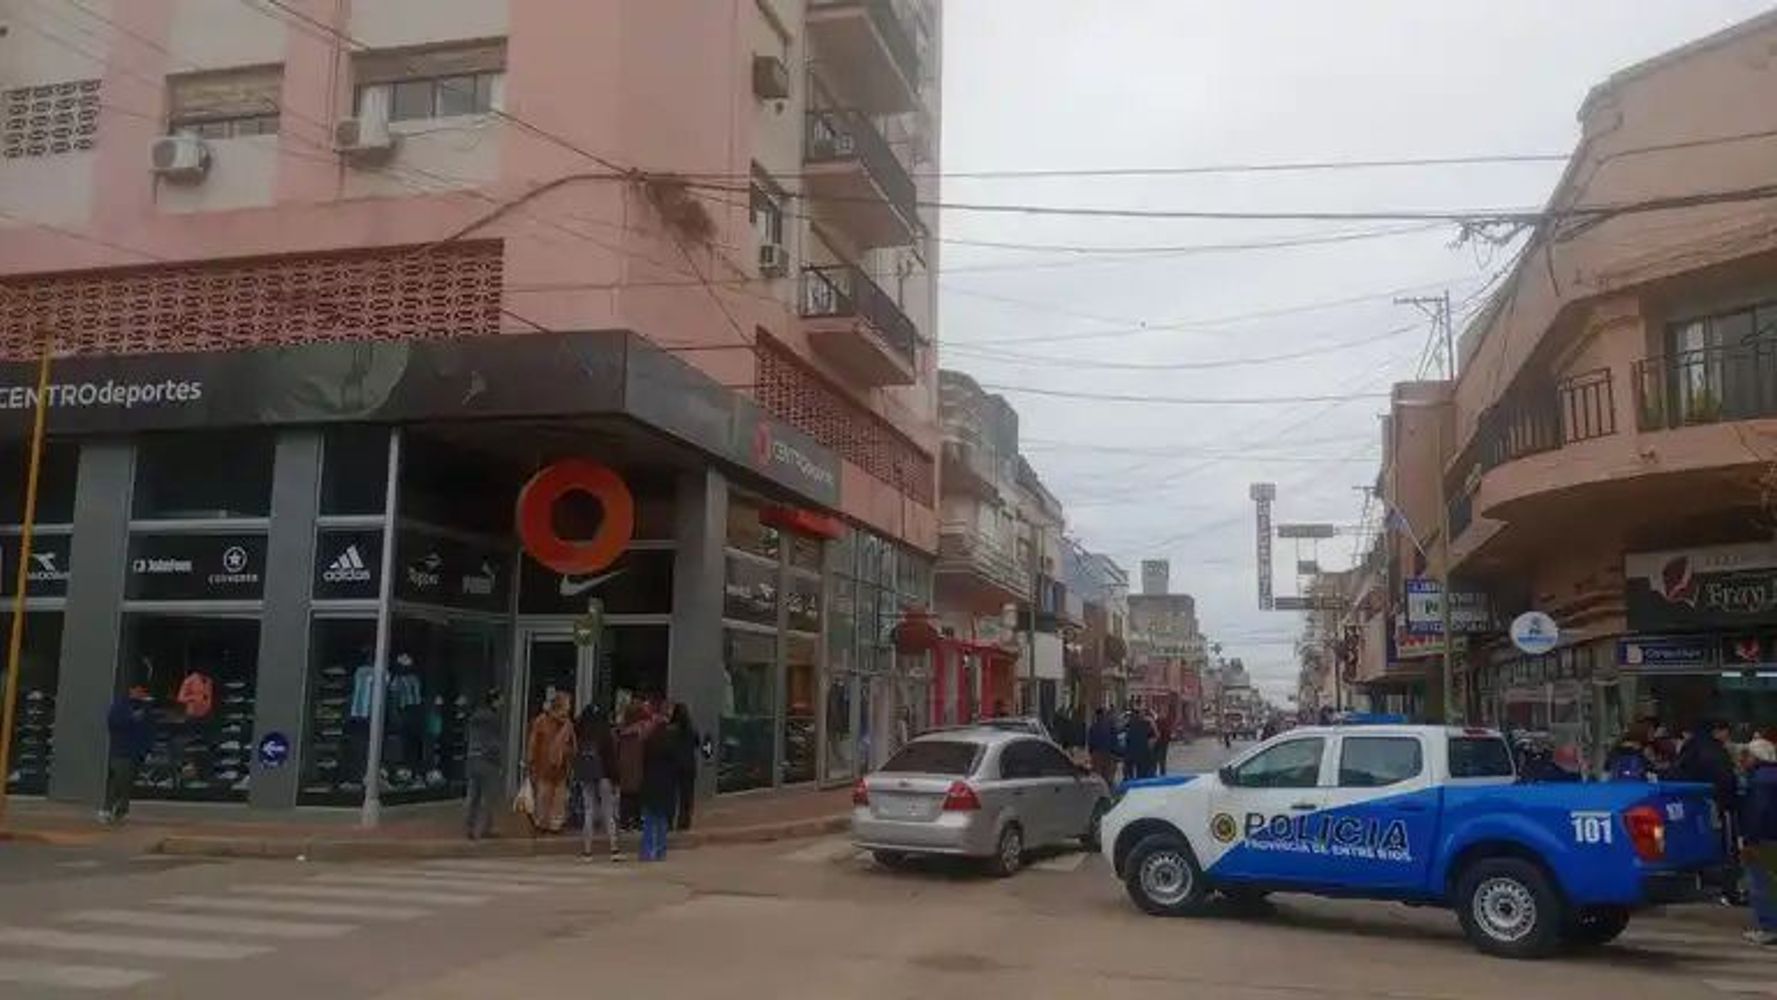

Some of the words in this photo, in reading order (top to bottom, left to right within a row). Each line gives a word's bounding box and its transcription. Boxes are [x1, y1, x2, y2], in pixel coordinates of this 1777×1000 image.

[323, 569, 371, 581] adidas
[1244, 812, 1408, 849] POLICIA
[1571, 817, 1612, 844] 101
